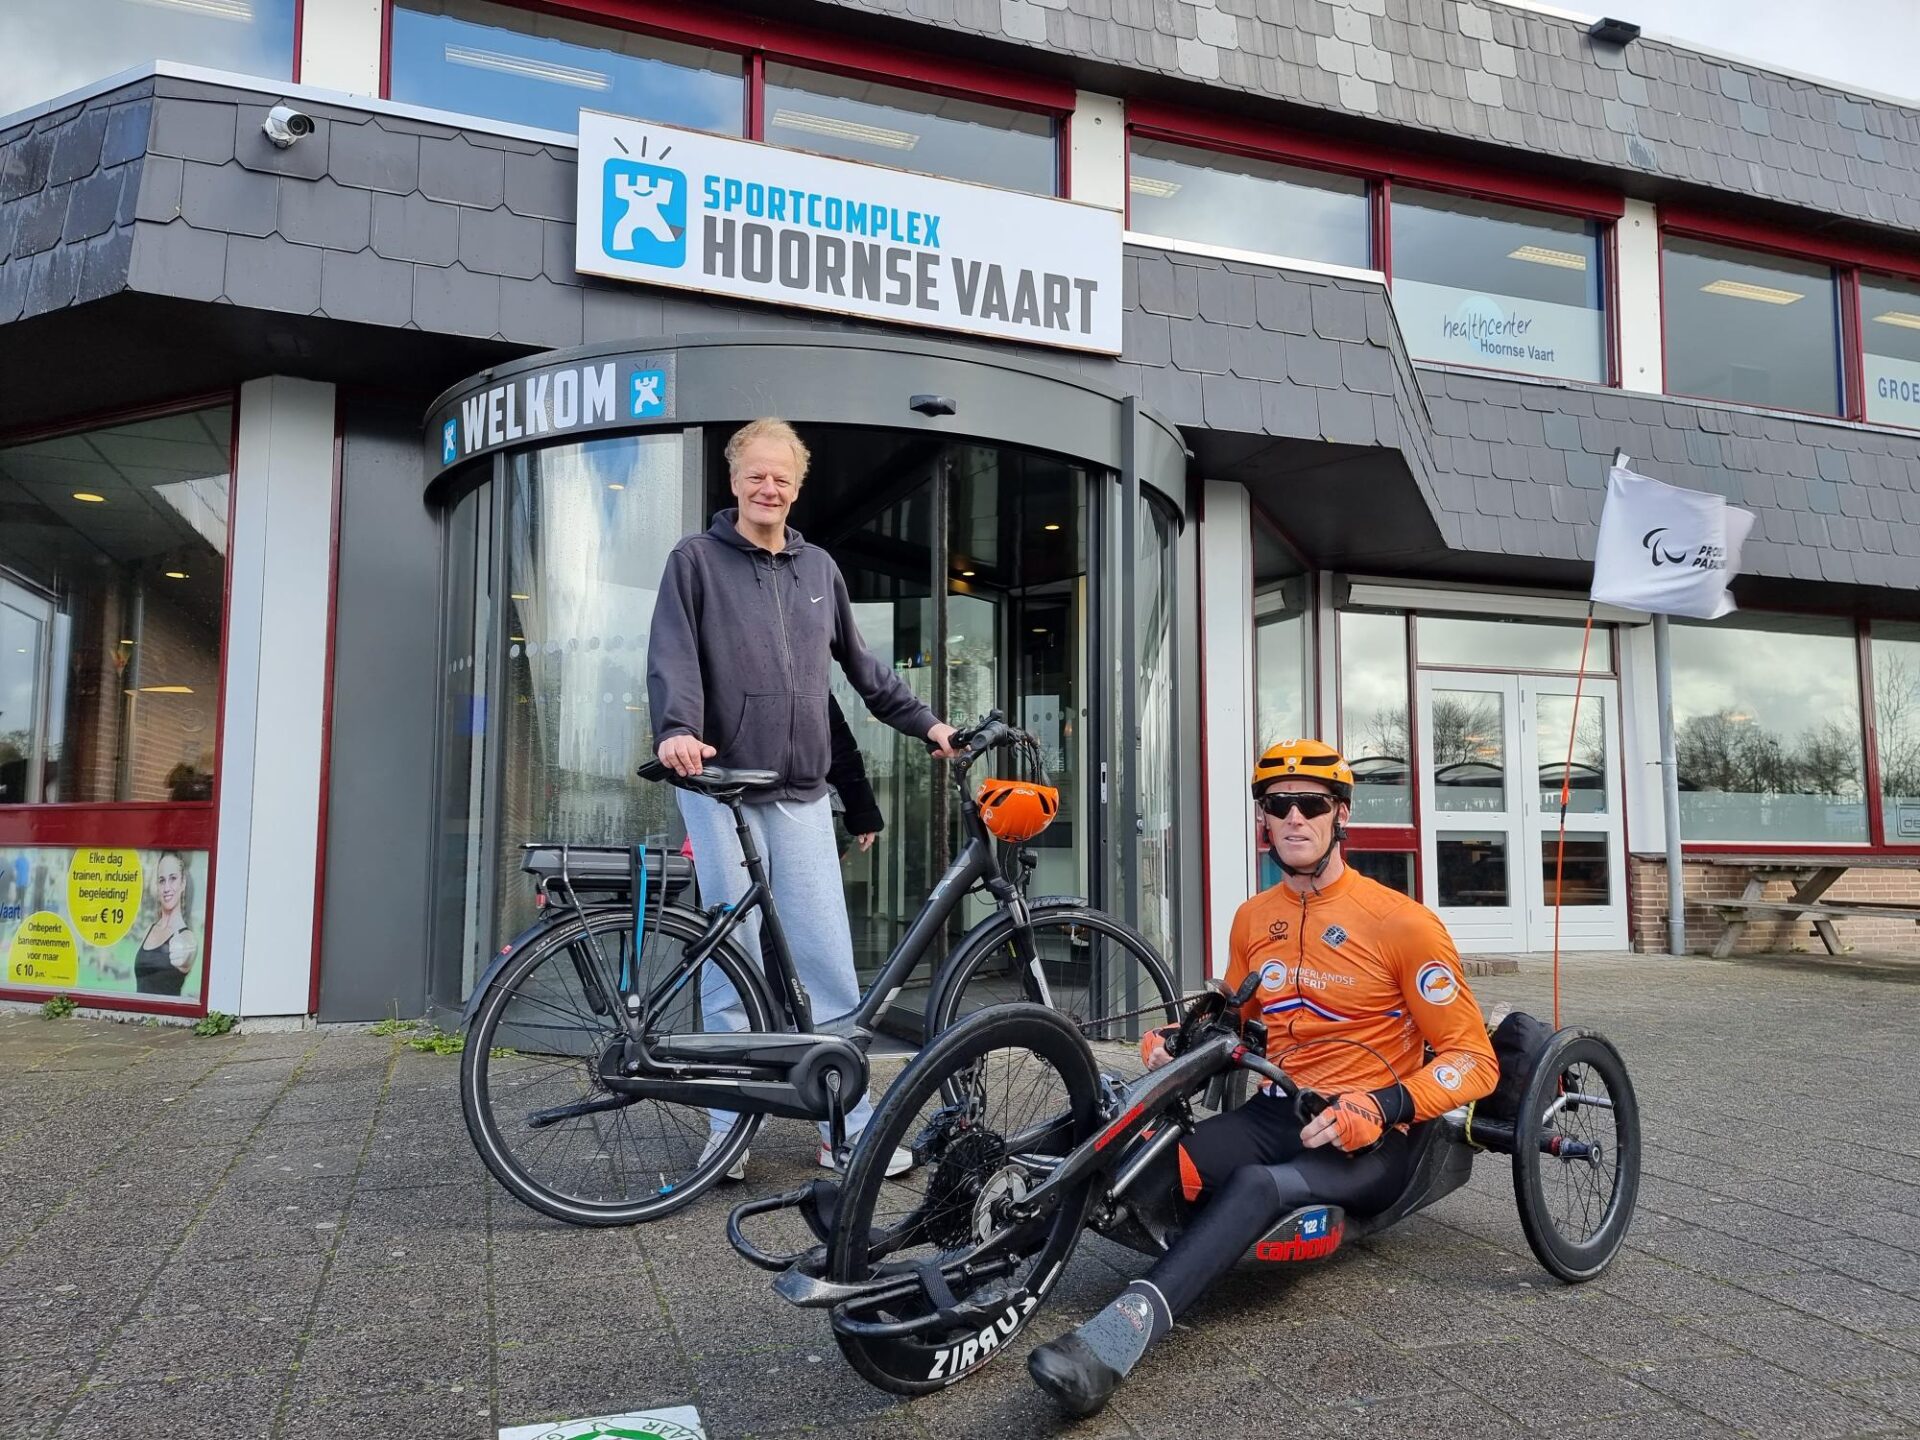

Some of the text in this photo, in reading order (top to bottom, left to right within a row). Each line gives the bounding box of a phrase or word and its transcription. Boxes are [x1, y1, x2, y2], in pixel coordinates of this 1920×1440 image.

[703, 175, 940, 248] SPORTCOMPLEX
[703, 215, 1098, 334] HOORNSE VAART
[1443, 311, 1533, 341] healthcenter
[1480, 338, 1555, 362] Hoornse Vaart
[462, 362, 616, 454] WELKOM
[89, 852, 123, 867] Elke dag
[105, 870, 139, 883] inclusief
[79, 887, 129, 903] begeleiding!
[81, 914, 98, 923] vanaf
[111, 908, 124, 924] 19
[28, 922, 62, 934] Onbeperkt
[18, 936, 70, 949] banenzwemmen
[27, 951, 60, 961] voor maar
[24, 964, 34, 977] 10
